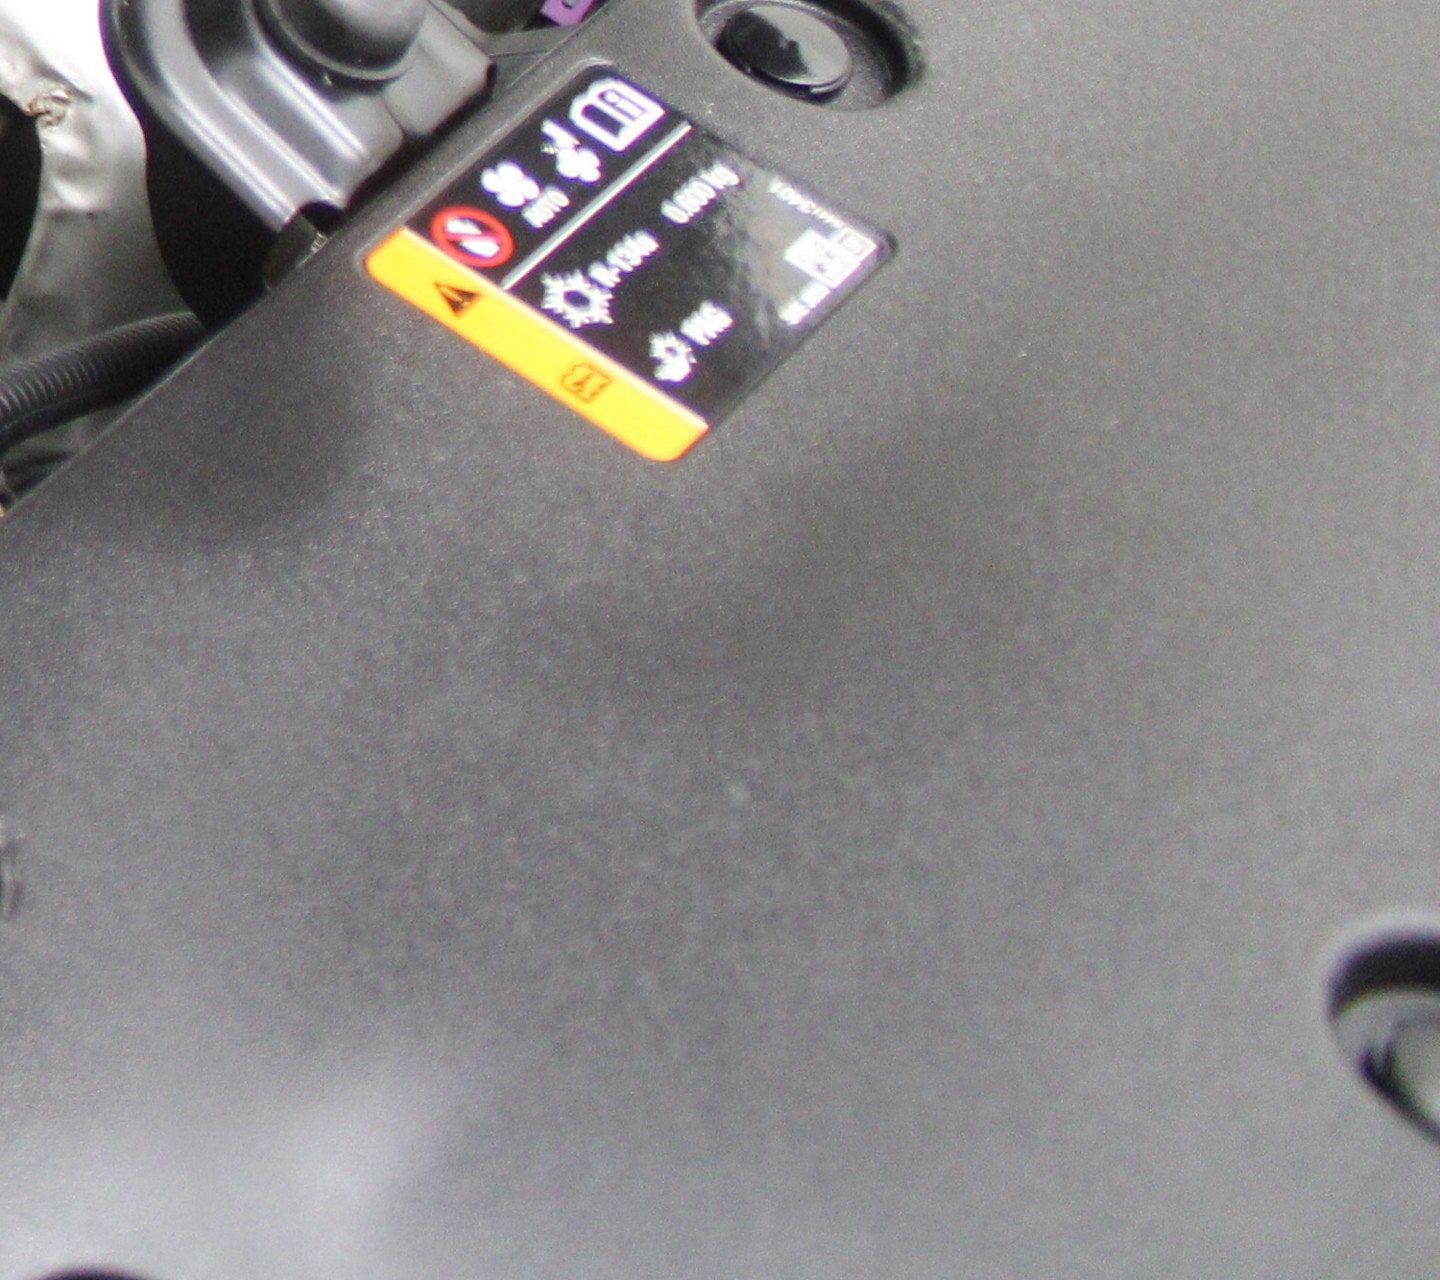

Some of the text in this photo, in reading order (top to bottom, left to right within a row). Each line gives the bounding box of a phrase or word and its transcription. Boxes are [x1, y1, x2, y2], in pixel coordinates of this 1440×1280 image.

[521, 185, 571, 229] AUTO
[587, 161, 742, 288] R-134a 0.600 kg
[680, 299, 734, 346] PAG
